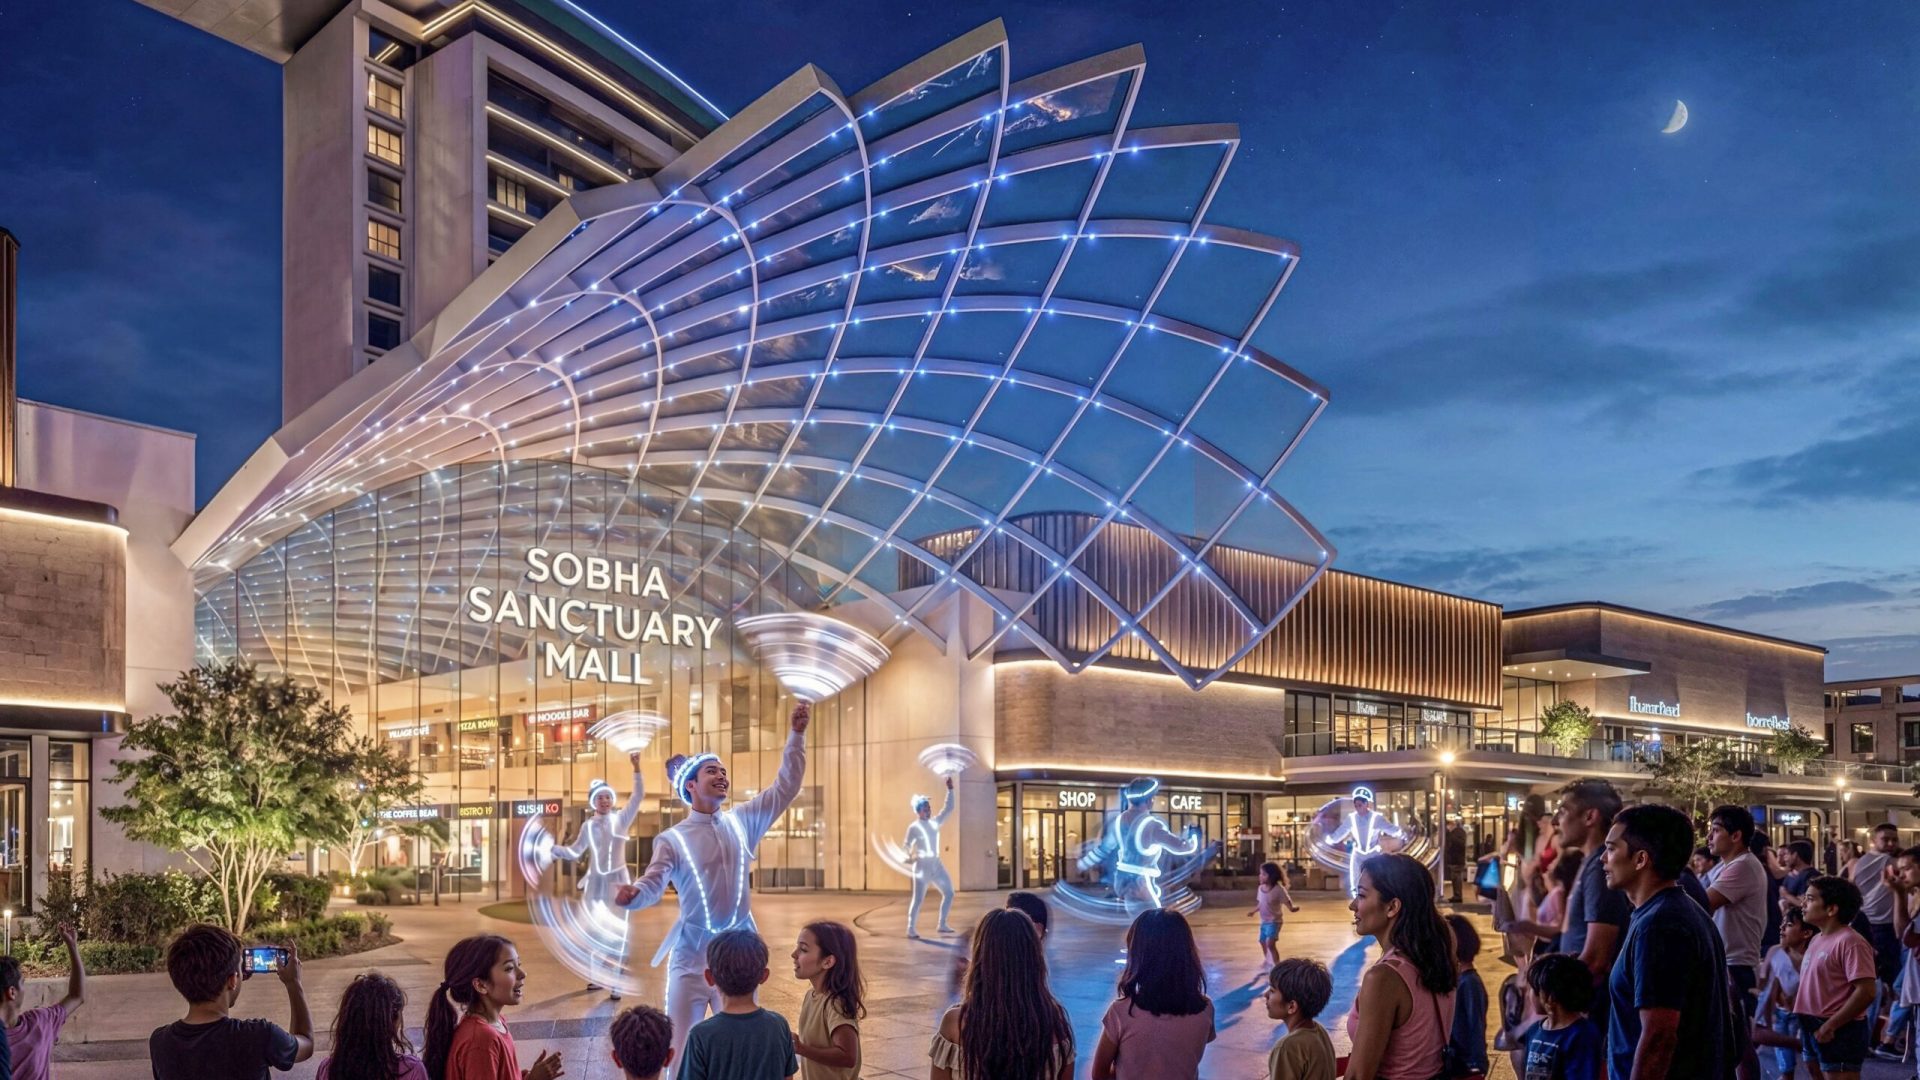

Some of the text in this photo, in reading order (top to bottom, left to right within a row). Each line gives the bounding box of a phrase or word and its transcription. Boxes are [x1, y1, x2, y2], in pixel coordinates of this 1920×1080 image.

[527, 547, 670, 600] SOBHA
[468, 586, 722, 649] SANCTUARY
[544, 642, 653, 685] MALL
[537, 708, 590, 722] NOODLE BAR
[457, 719, 499, 731] PIZZA ROMA
[388, 728, 413, 739] VILLAGE
[1059, 791, 1096, 807] SHOP
[1170, 795, 1202, 810] CAFE
[379, 808, 438, 818] THE COFFEE BEAN
[459, 806, 493, 816] BISTRO 19
[517, 803, 559, 815] SUSHI KO
